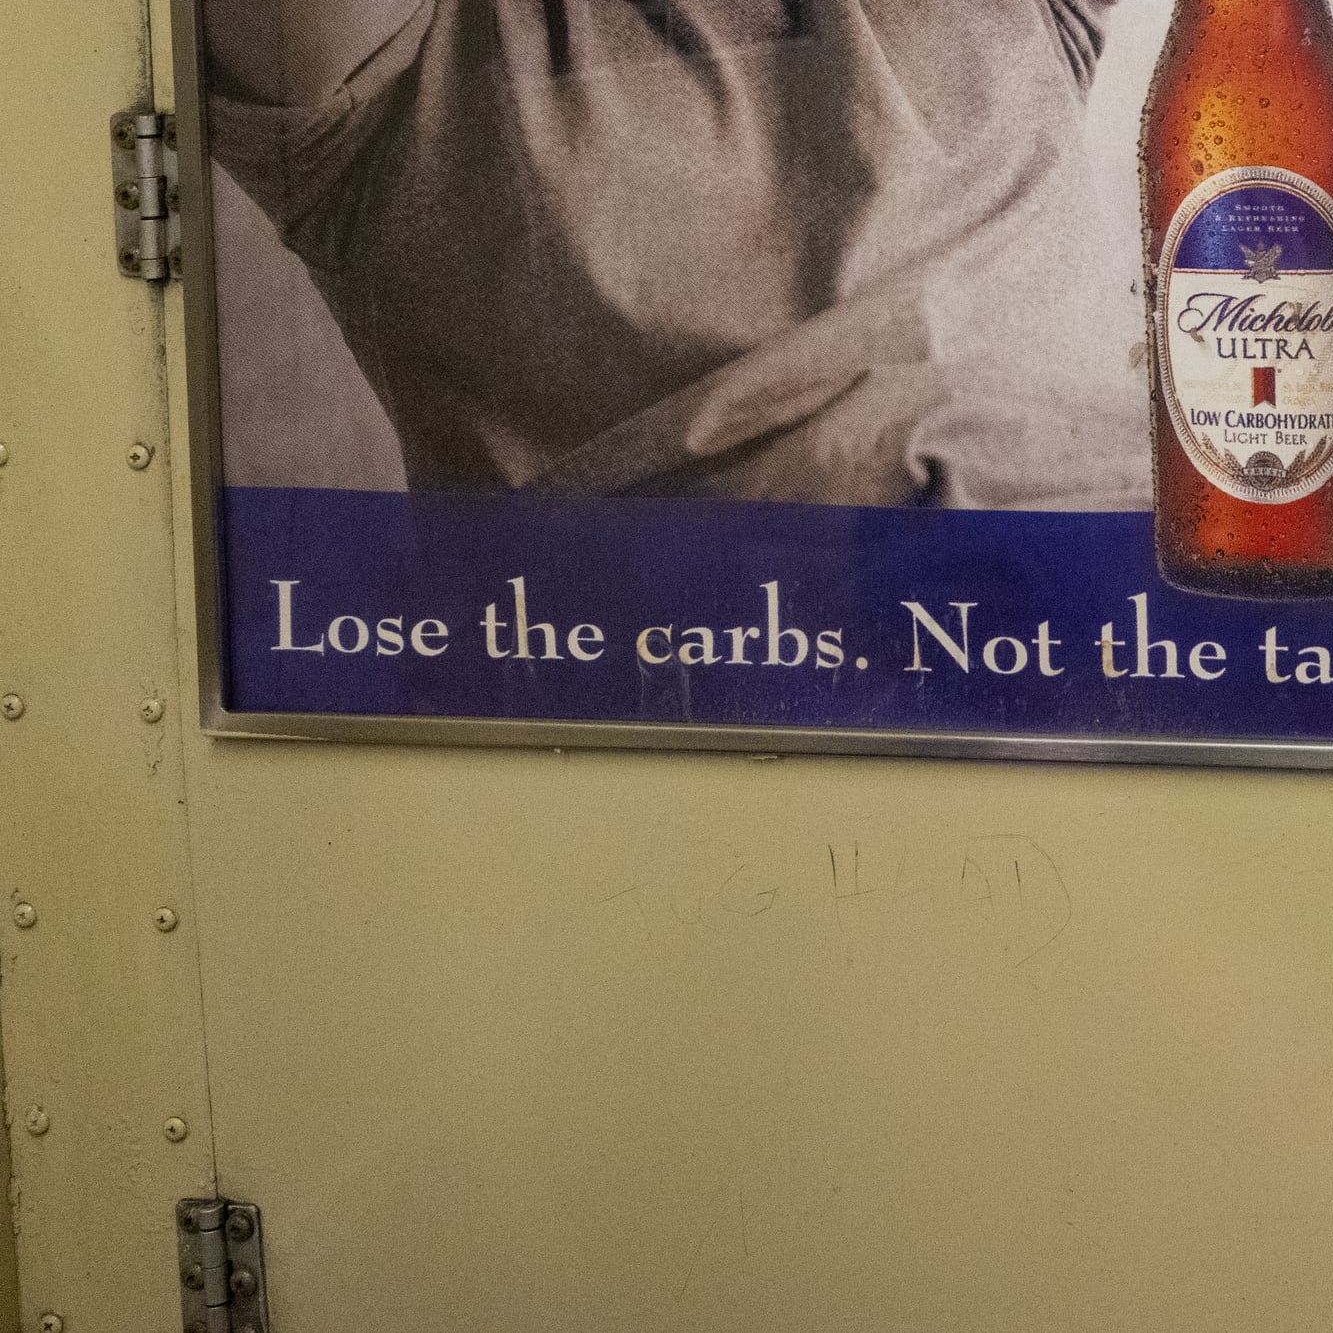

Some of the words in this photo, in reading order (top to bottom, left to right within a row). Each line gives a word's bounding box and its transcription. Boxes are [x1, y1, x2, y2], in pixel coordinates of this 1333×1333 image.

[1216, 337, 1315, 360] ULTRA
[1190, 408, 1221, 427] LOW
[1223, 429, 1269, 445] LIGHT
[1274, 431, 1309, 446] BEER
[270, 579, 449, 657] Lose
[479, 575, 605, 662] the
[636, 579, 869, 670] carbs.
[900, 600, 1064, 677] Not
[1100, 591, 1228, 681] the
